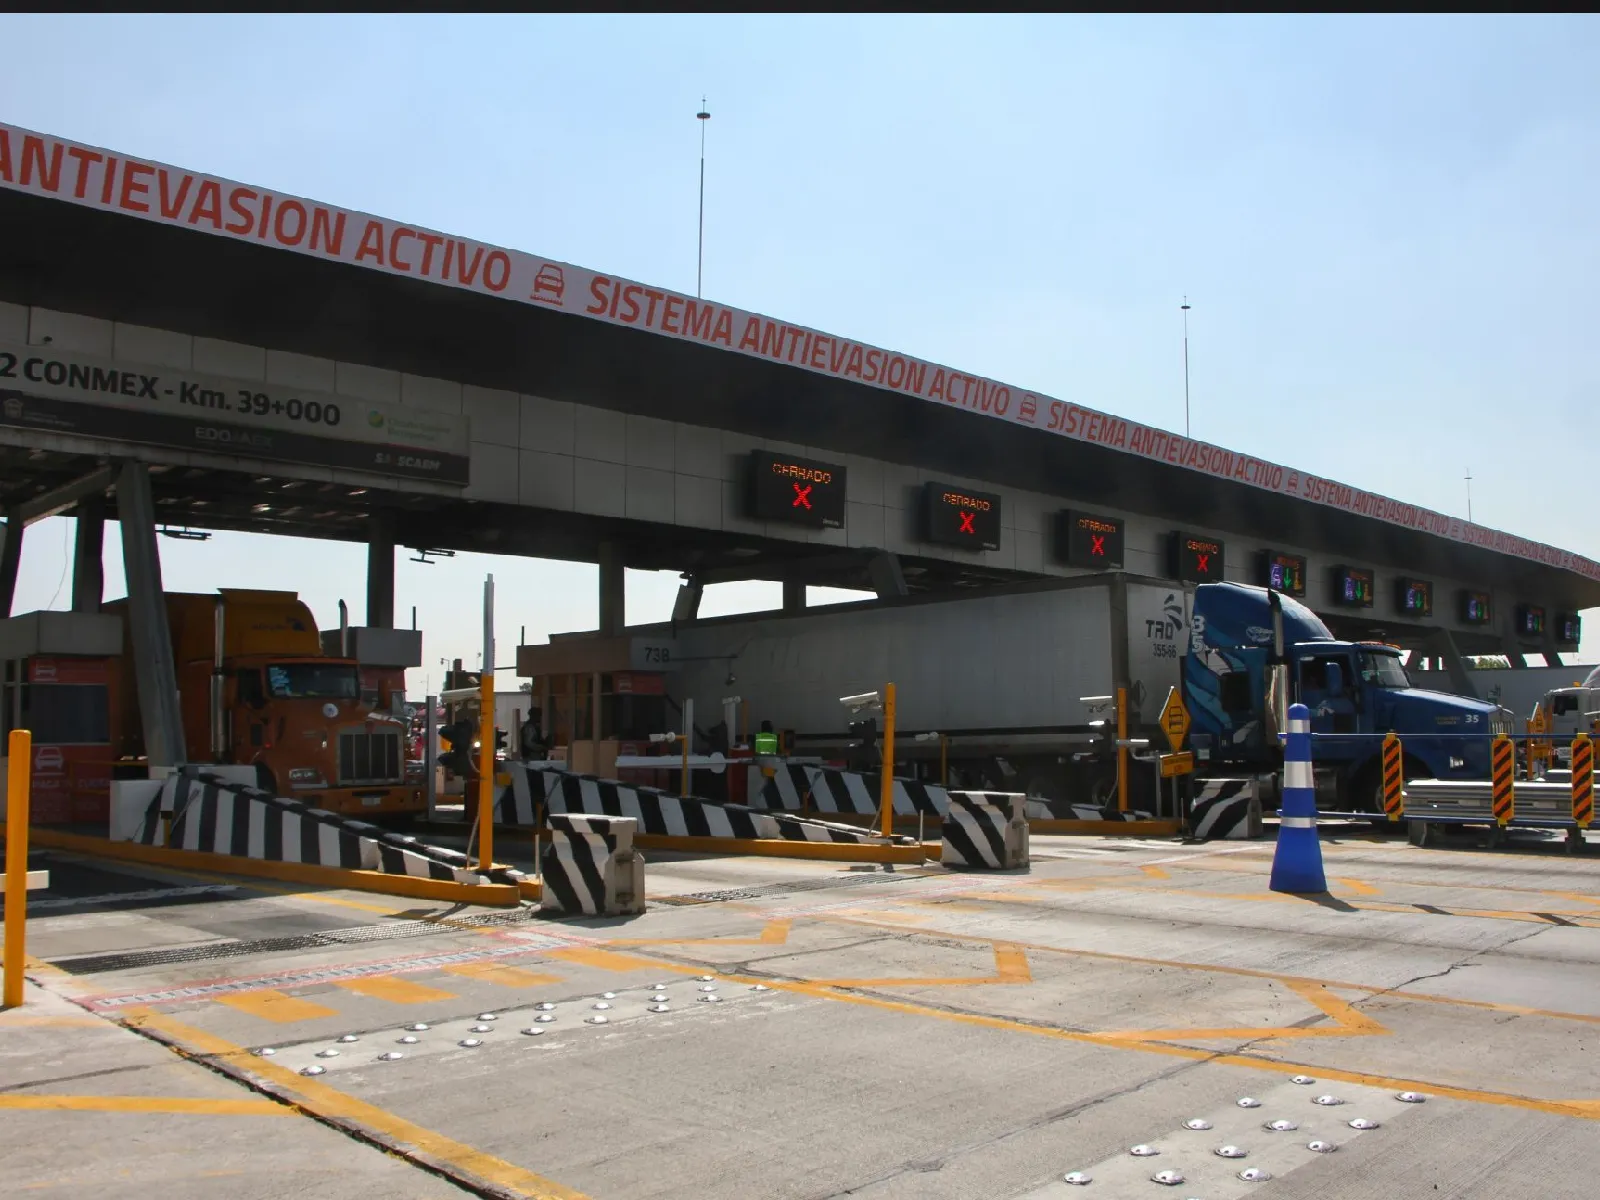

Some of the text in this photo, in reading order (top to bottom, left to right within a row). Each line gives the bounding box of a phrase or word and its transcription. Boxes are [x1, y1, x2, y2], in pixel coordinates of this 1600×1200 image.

[355, 221, 511, 291] ACTIVO
[586, 276, 1011, 416] SISTEMA ANTIEVASION ACTIVO
[23, 358, 160, 400] CONMEX
[179, 381, 232, 410] Km.
[237, 390, 341, 426] 39+000
[1047, 401, 1282, 490] SISTEMA ANTIEVASION ACTIVO
[1303, 477, 1450, 535] SISTEMA ANTIEVASION ACTIVO
[1464, 714, 1480, 724] 35
